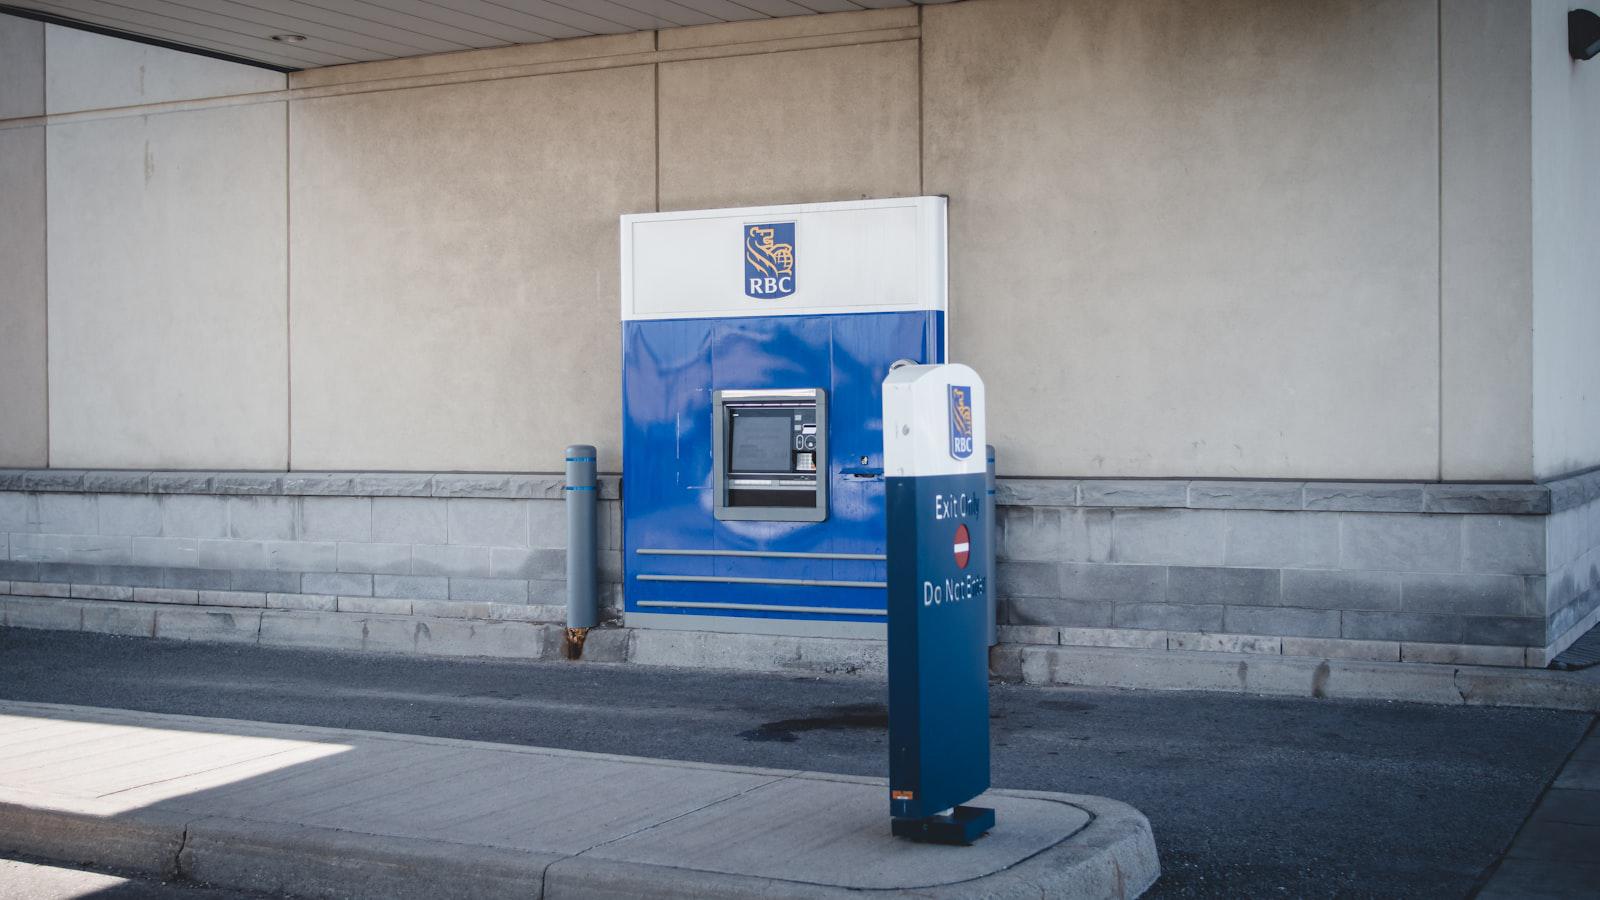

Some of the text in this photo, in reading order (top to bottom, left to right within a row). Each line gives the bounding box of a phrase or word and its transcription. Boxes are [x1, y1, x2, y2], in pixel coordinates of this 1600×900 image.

[749, 276, 791, 294] RBC
[954, 437, 972, 452] RBC
[935, 494, 958, 520] Exit
[923, 580, 942, 606] Do
